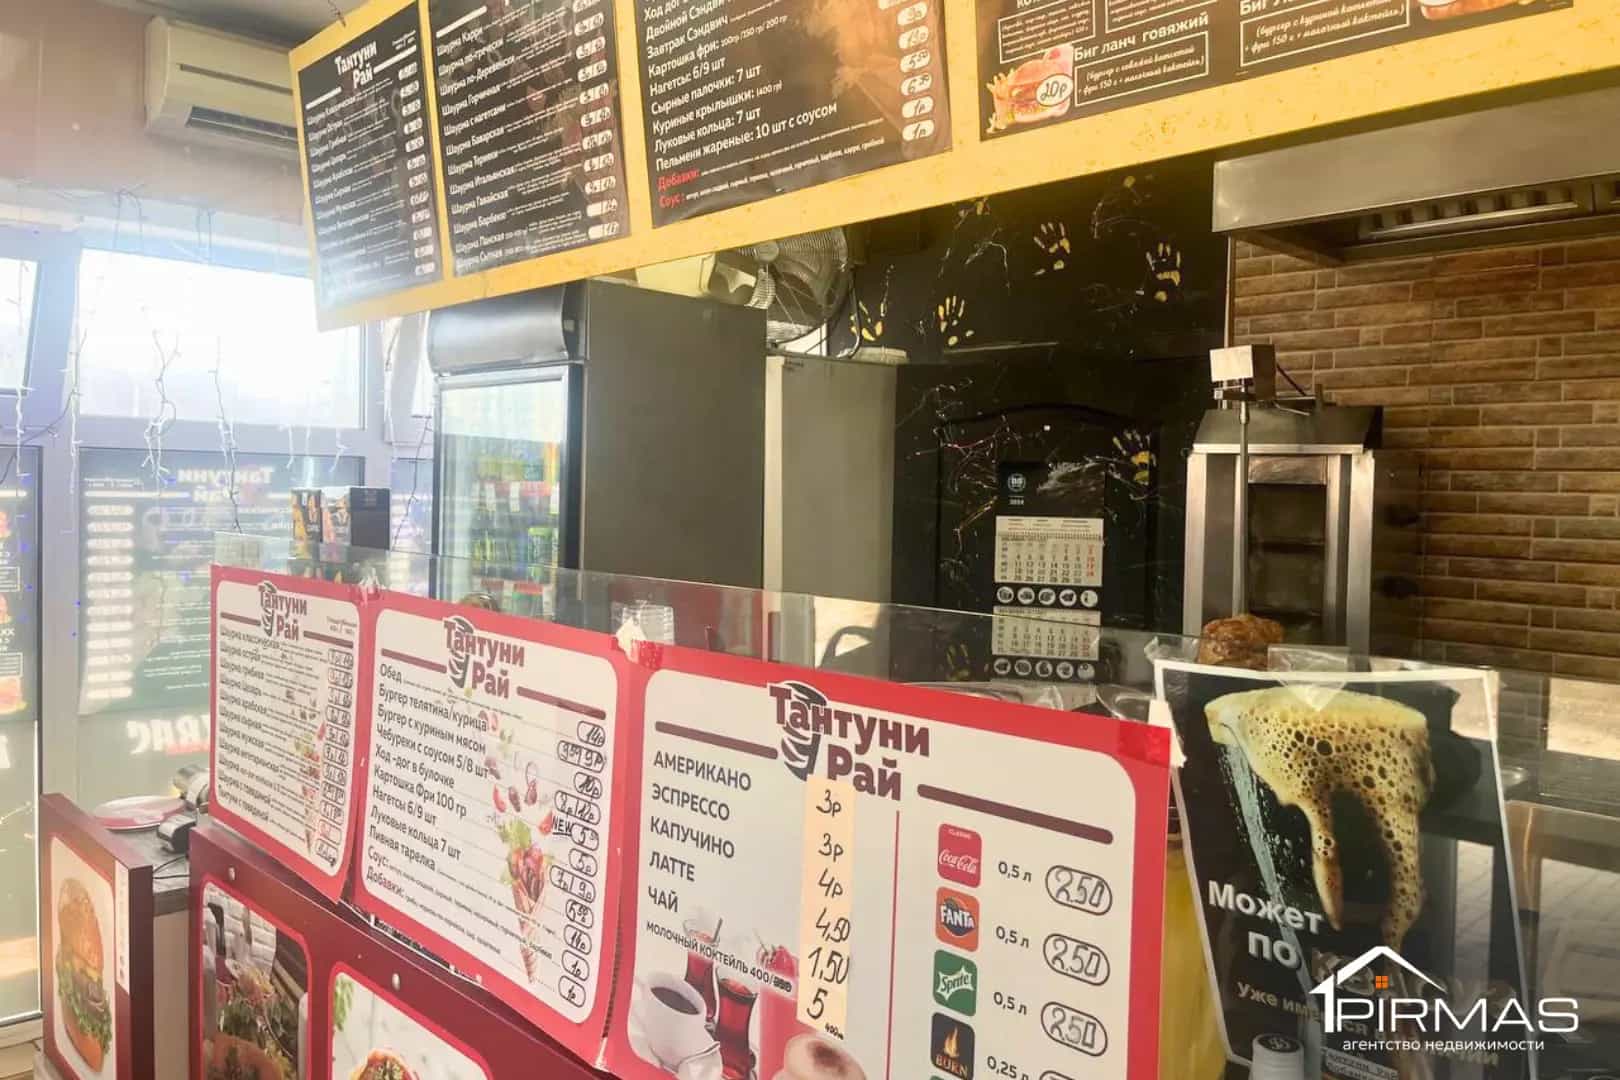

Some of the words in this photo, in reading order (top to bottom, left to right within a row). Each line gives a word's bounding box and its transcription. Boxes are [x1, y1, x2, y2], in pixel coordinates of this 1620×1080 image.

[644, 6, 664, 21] Ход
[646, 10, 688, 42] Двойной
[689, 0, 732, 20] Сэндви
[647, 34, 686, 59] Завтрак
[687, 16, 729, 41] Сэндвич
[1074, 45, 1097, 62] Биг
[1101, 34, 1137, 55] ланч
[1142, 10, 1209, 42] говяжий
[334, 41, 377, 76] Тантуни
[353, 63, 373, 89] Рай
[648, 51, 696, 78] Картошка
[696, 40, 720, 60] фри:
[650, 71, 692, 97] Нагетсы:
[693, 61, 710, 80] 6/9
[711, 57, 726, 72] шт
[652, 92, 689, 115] Сырные
[691, 74, 736, 101] палочки:
[736, 67, 744, 82] 7
[746, 64, 762, 79] шт
[653, 113, 694, 136] Куриные
[695, 90, 755, 118] крылышки:
[654, 132, 696, 153] Луковые
[696, 119, 736, 139] кольца:
[736, 111, 744, 125] 7
[745, 106, 761, 121] шт
[656, 150, 702, 172] Пельмени
[702, 130, 755, 156] жареные:
[756, 123, 770, 139] 10
[772, 119, 787, 134] шт
[796, 102, 838, 127] соусом
[258, 584, 308, 618] Тантуни
[276, 615, 300, 641] Рай
[443, 620, 525, 668] Тантуни
[380, 663, 403, 685] Обед
[472, 660, 510, 699] Рай
[379, 683, 409, 707] Бургер
[409, 697, 488, 733] телятина/курица
[769, 685, 931, 757] Тантуни
[377, 703, 407, 728] Бургер
[414, 720, 455, 744] куриным
[456, 736, 487, 756] мясом
[375, 743, 391, 762] Ход
[418, 761, 456, 790] булочке
[377, 723, 417, 751] Чебуреки
[423, 745, 456, 764] соусом
[456, 754, 474, 773] 5/8
[474, 764, 489, 778] шт
[373, 763, 415, 793] Картошка
[436, 791, 455, 812] 100
[456, 803, 467, 820] гр
[652, 750, 752, 793] АМЕРИКАНО
[826, 743, 902, 801] Рай
[372, 784, 406, 810] Нагетсы
[407, 800, 424, 819] 6/9
[424, 813, 437, 827] шт
[651, 782, 730, 822] ЭСПРЕССО
[816, 788, 842, 817] 3р
[369, 824, 400, 852] Пивная
[401, 845, 436, 872] тарелка
[370, 804, 407, 834] Луковые
[408, 822, 439, 851] кольца
[440, 836, 447, 853] 7
[447, 845, 462, 861] шт
[649, 814, 736, 860] КАПУЧИНО
[818, 832, 844, 862] 3р
[368, 845, 389, 868] Соус:
[649, 850, 696, 883] ЛАТТЕ
[998, 860, 1020, 879] 0,5
[1022, 871, 1033, 883] л
[648, 884, 679, 913] ЧАЙ
[817, 867, 844, 899] 4р
[1207, 879, 1324, 935] Может
[646, 920, 699, 953] МОЛОЧНЫЙ
[699, 942, 749, 975] КОКТЕЙЛЬ
[995, 925, 1018, 945] 0,5
[1020, 936, 1030, 949] л
[941, 972, 970, 993] Sprite
[1236, 980, 1279, 1009] уже
[806, 987, 829, 1020] 5
[992, 991, 1016, 1012] 0,5
[1018, 1002, 1028, 1016] л
[935, 1053, 969, 1078] BURN
[986, 1055, 1018, 1078] 0,25
